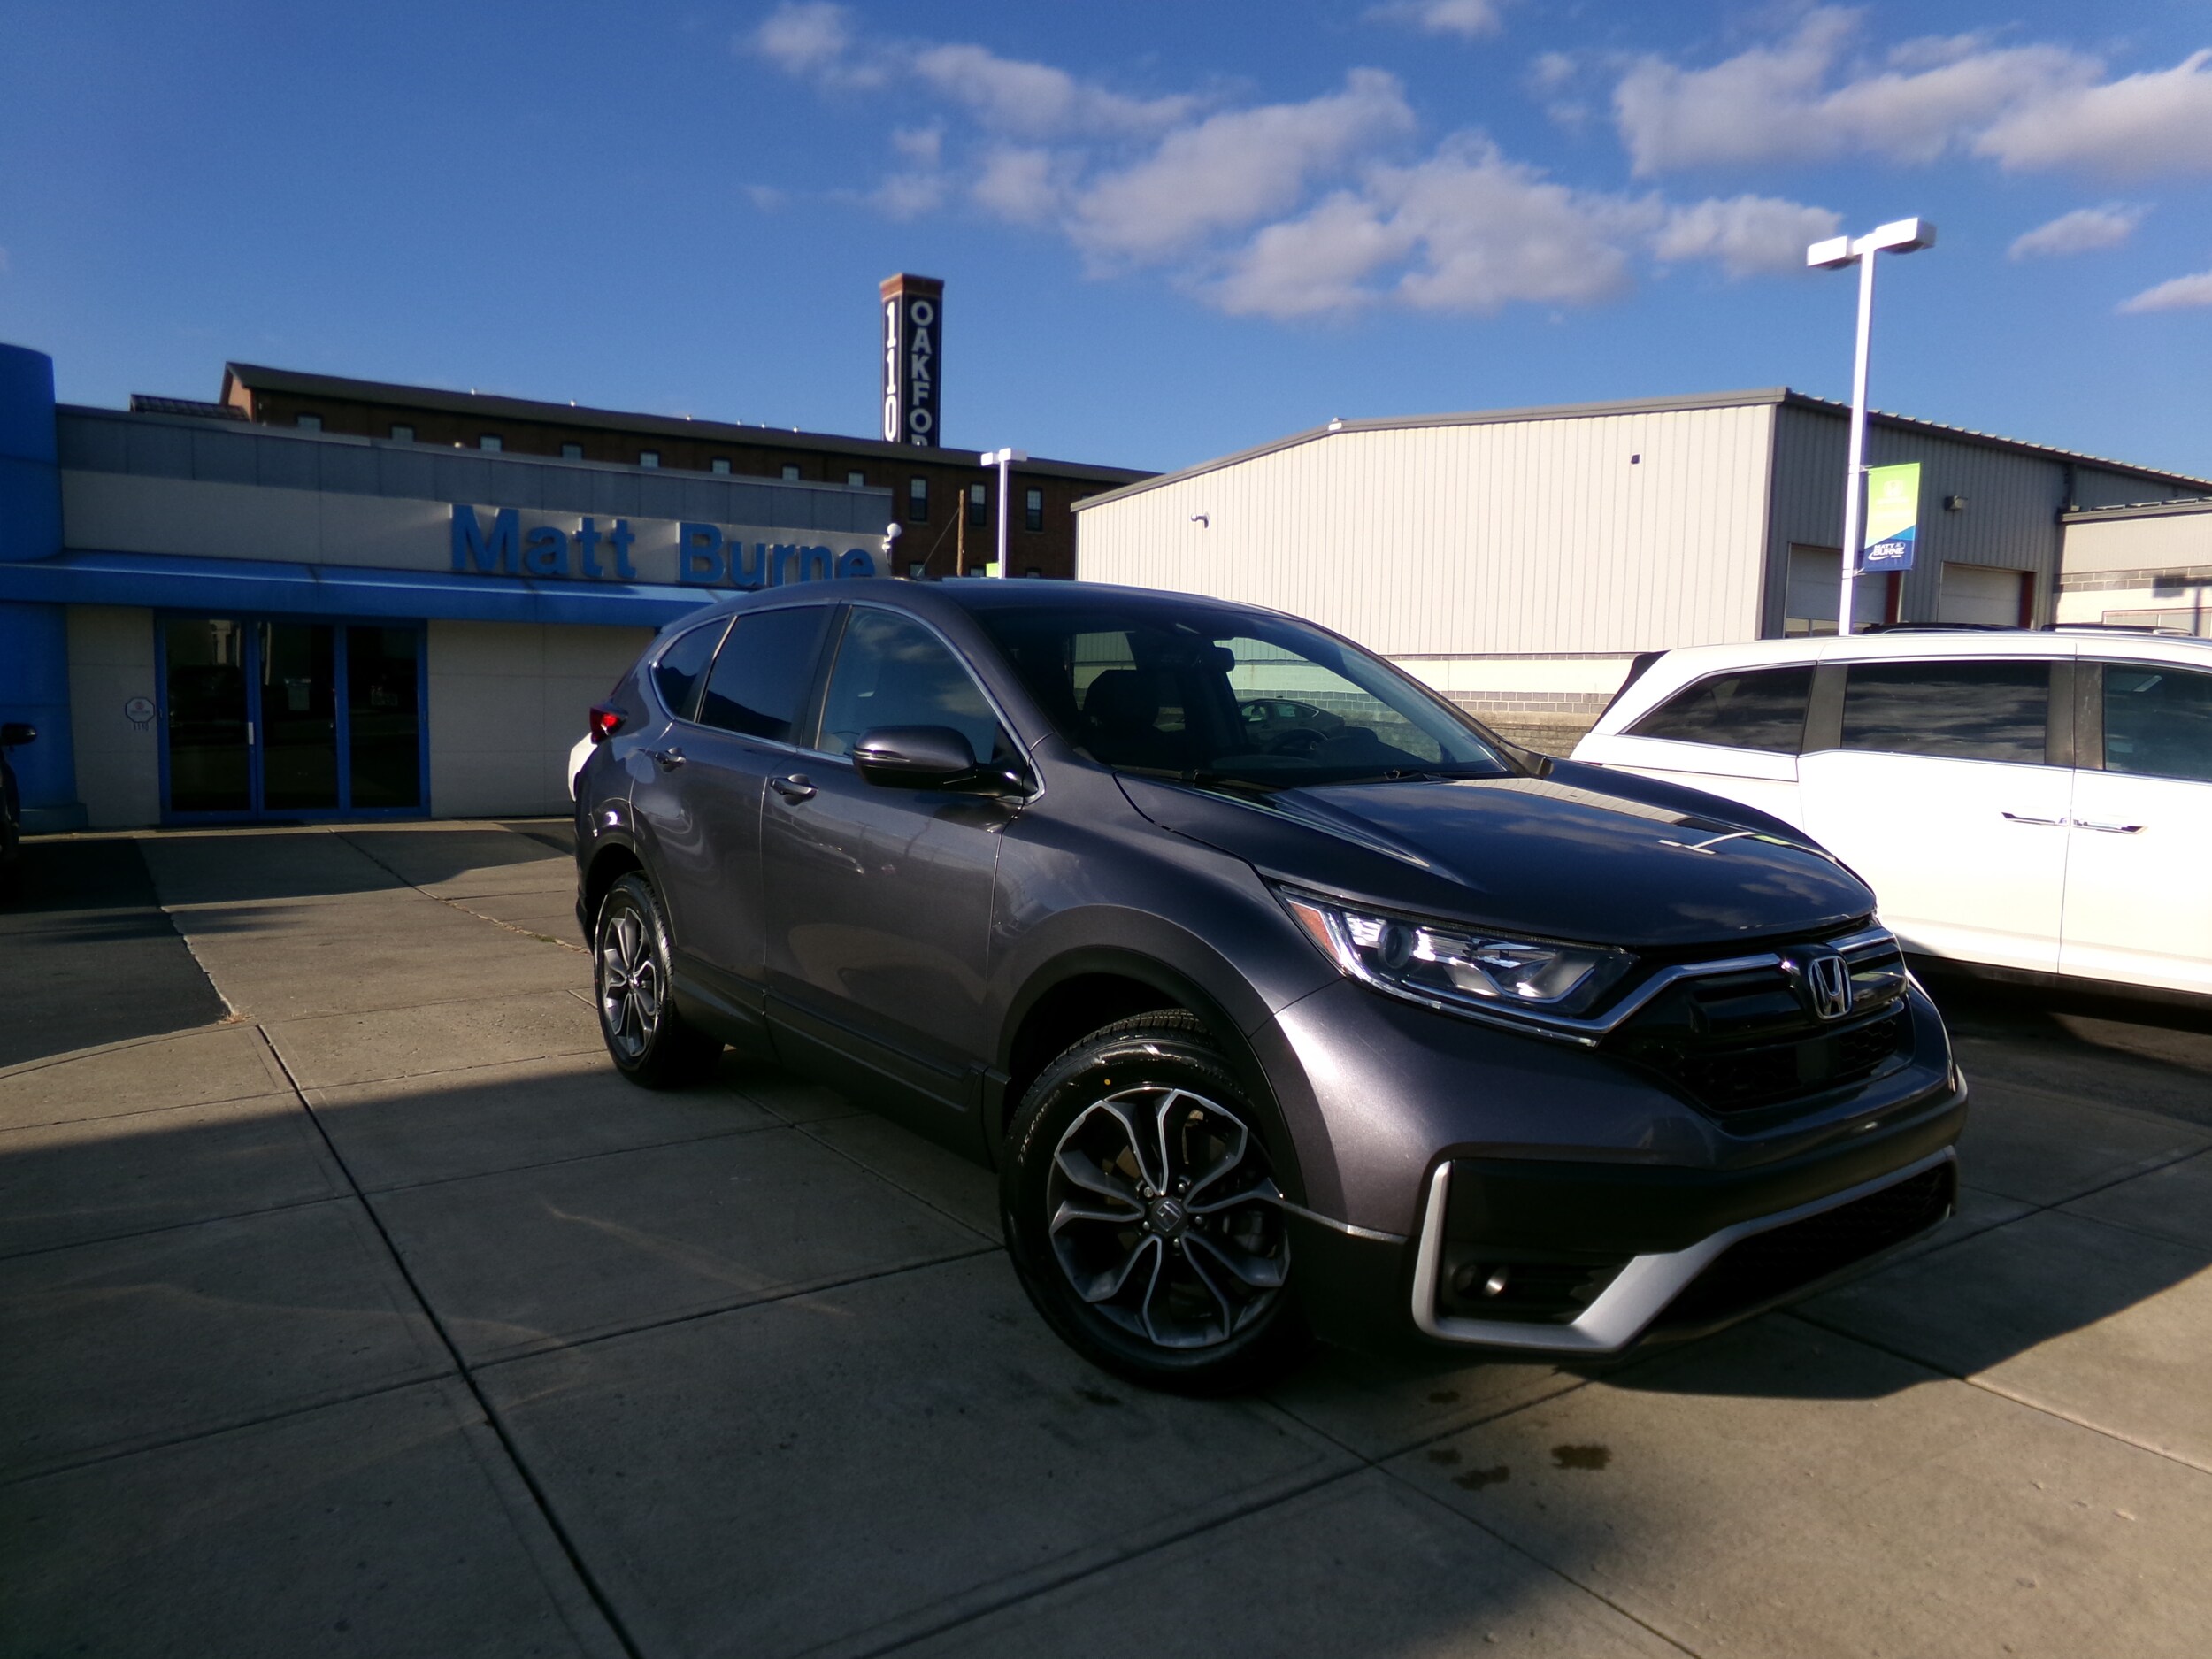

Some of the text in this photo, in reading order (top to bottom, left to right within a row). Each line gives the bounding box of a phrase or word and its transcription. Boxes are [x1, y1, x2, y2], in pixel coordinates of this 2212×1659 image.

[449, 503, 876, 587] Matt Burne
[1873, 546, 1905, 557] BURNE
